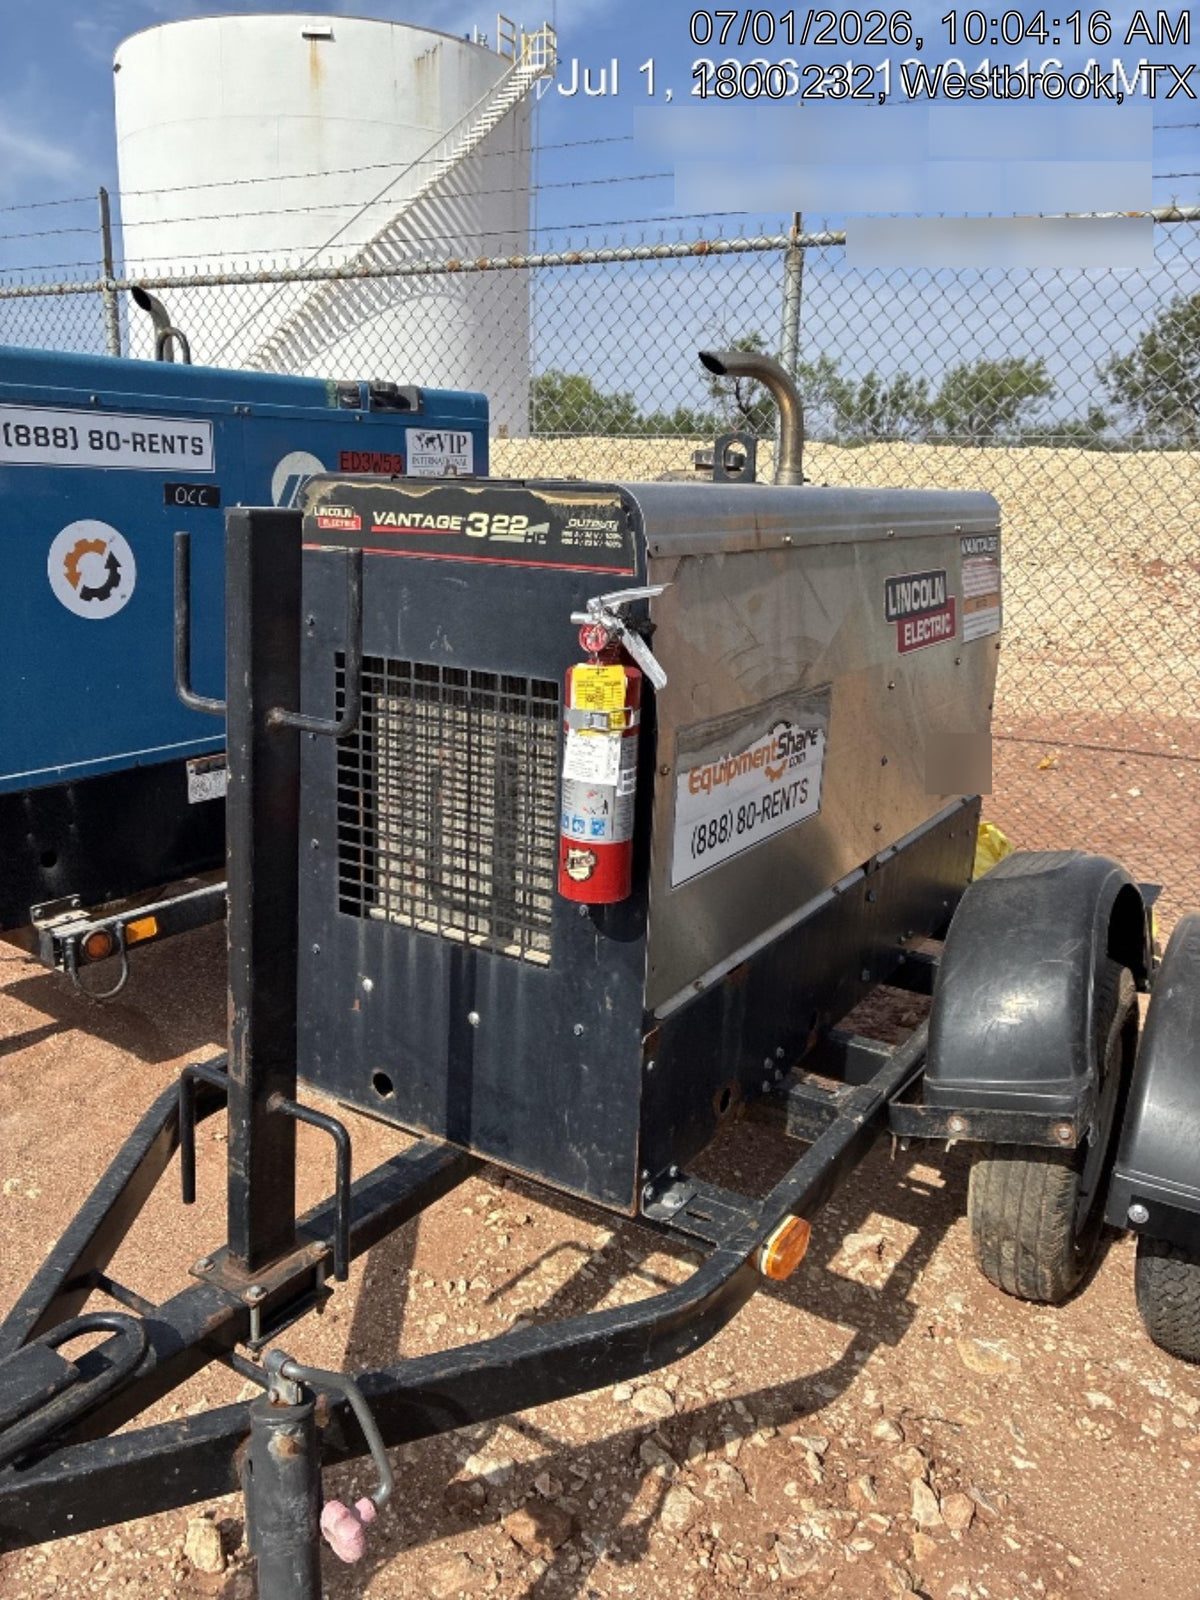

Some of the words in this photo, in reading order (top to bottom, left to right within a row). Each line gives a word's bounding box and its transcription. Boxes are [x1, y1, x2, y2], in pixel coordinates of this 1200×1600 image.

[3, 422, 79, 450] (888)
[88, 429, 204, 456] 80-RENTS
[437, 433, 467, 454] VIP
[313, 505, 353, 518] LINCOLN
[372, 511, 461, 530] VANTAGE
[465, 511, 529, 538] 322
[888, 576, 945, 616] LINCOLN
[904, 613, 951, 647] ELECTRIC
[688, 728, 818, 795] EquipmentShare
[691, 809, 733, 859] (888)
[737, 778, 810, 835] 80-RENTS
